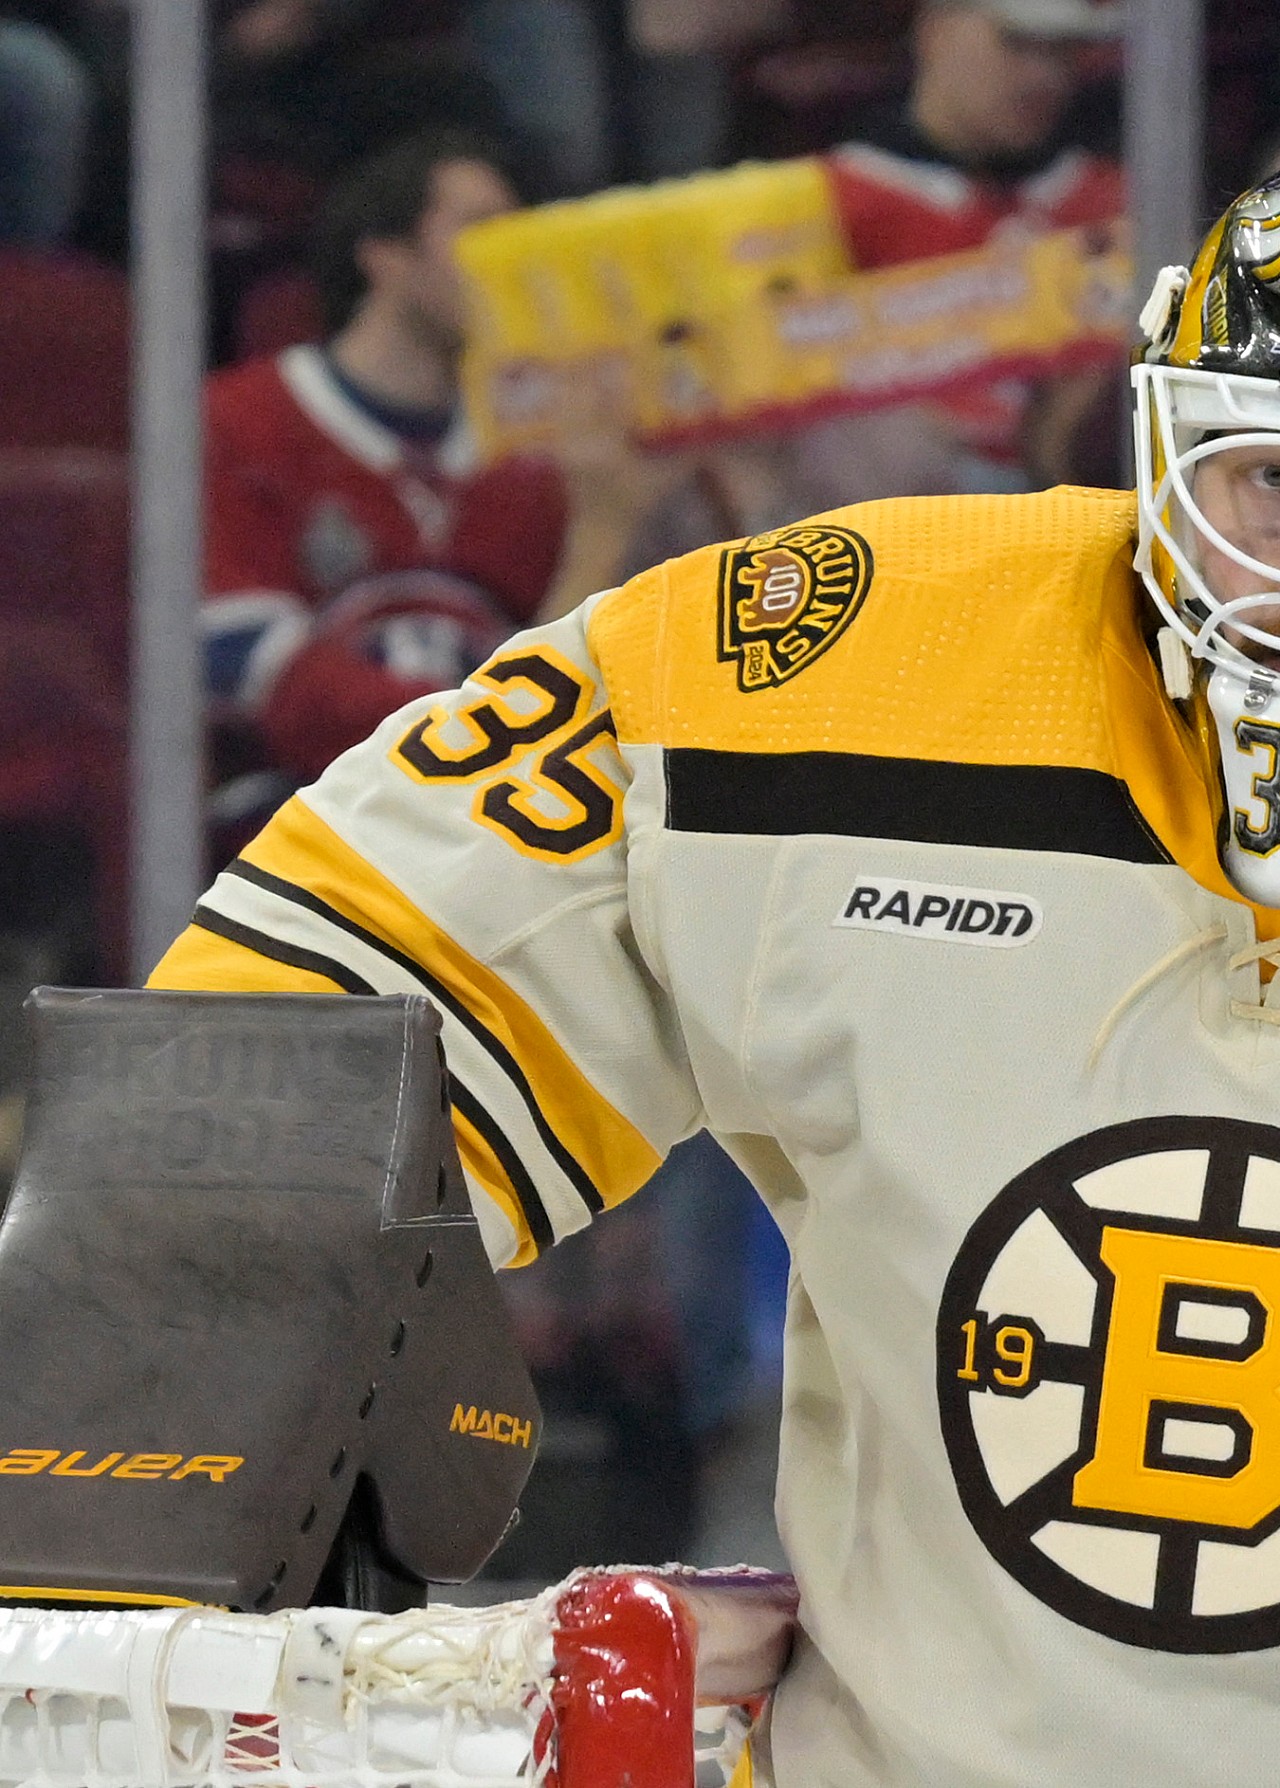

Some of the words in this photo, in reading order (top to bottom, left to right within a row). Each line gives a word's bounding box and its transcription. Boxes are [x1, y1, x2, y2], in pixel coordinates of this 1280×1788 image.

[762, 564, 800, 611] 100
[776, 531, 855, 662] BRUINS
[387, 643, 626, 866] 35
[956, 1318, 1034, 1388] 19
[449, 1402, 533, 1449] MACH
[0, 1448, 244, 1483] AUER
